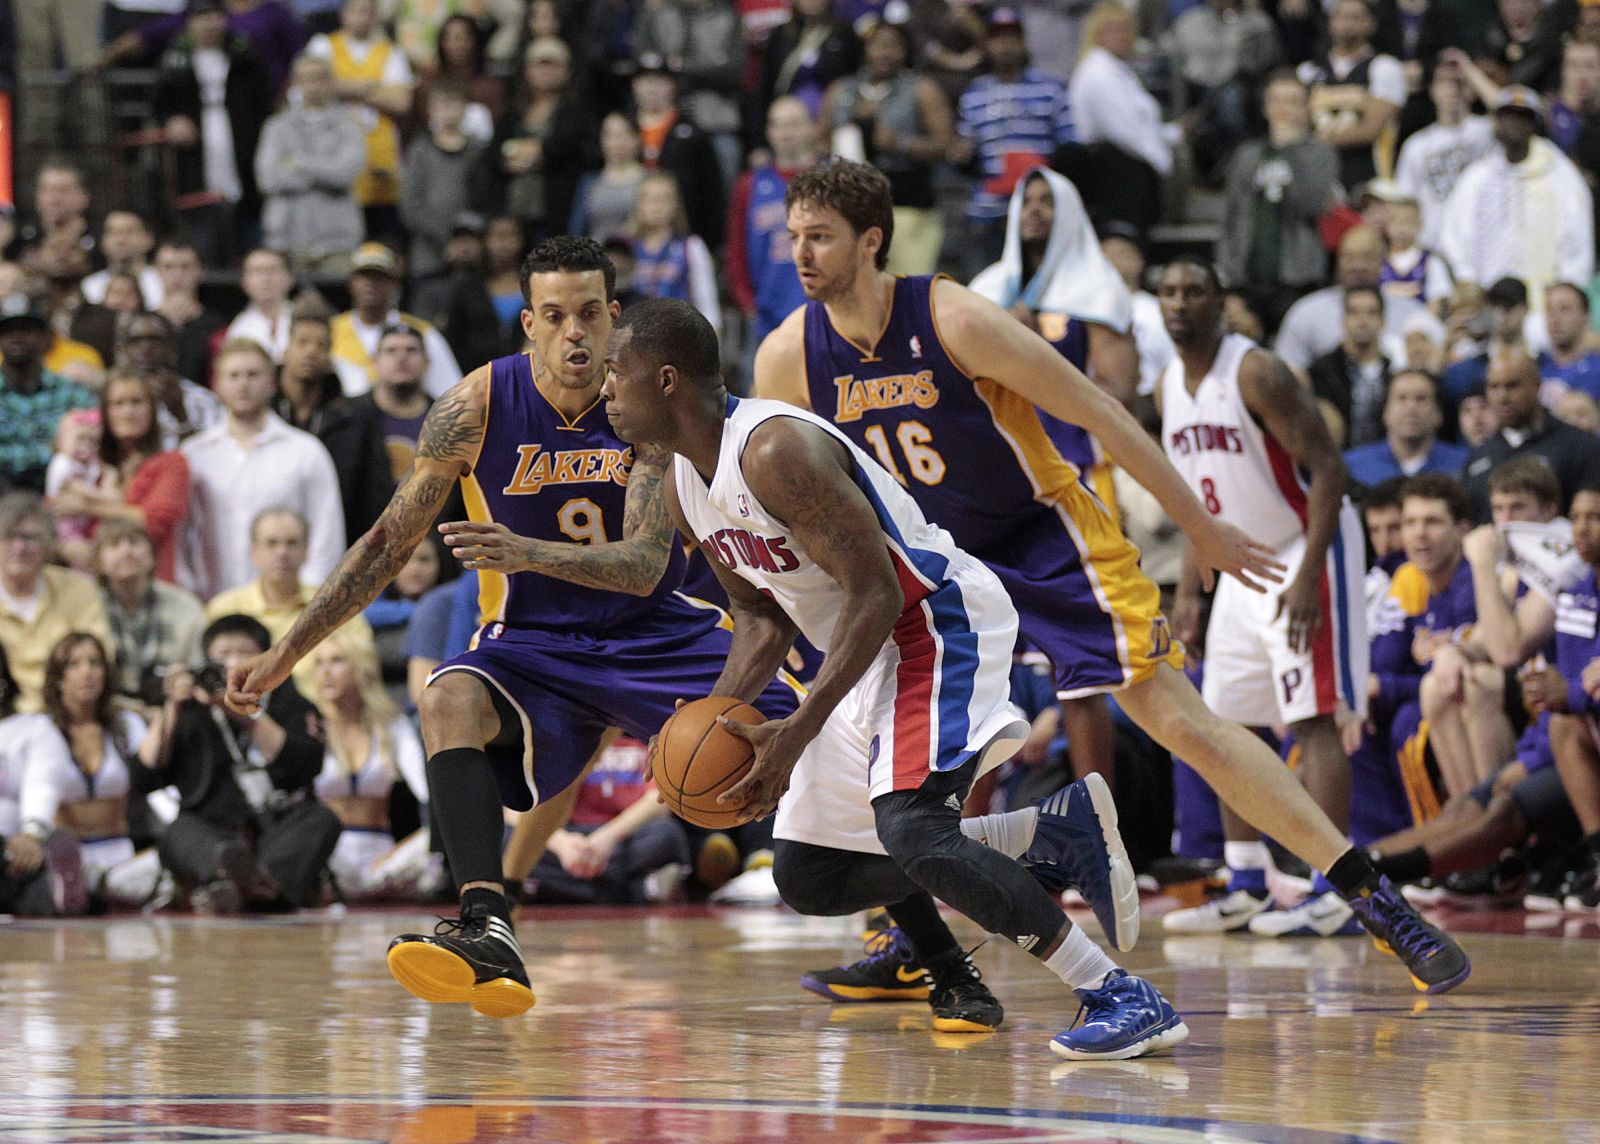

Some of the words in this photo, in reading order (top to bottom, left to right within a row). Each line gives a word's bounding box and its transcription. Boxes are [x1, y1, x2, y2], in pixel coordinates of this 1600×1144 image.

[835, 370, 940, 424] LAKERS
[864, 420, 946, 488] 16
[1172, 424, 1243, 455] PSTONS
[502, 443, 636, 496] LAKERS
[1201, 478, 1220, 514] 8
[556, 497, 608, 546] 9
[1281, 668, 1301, 704] P
